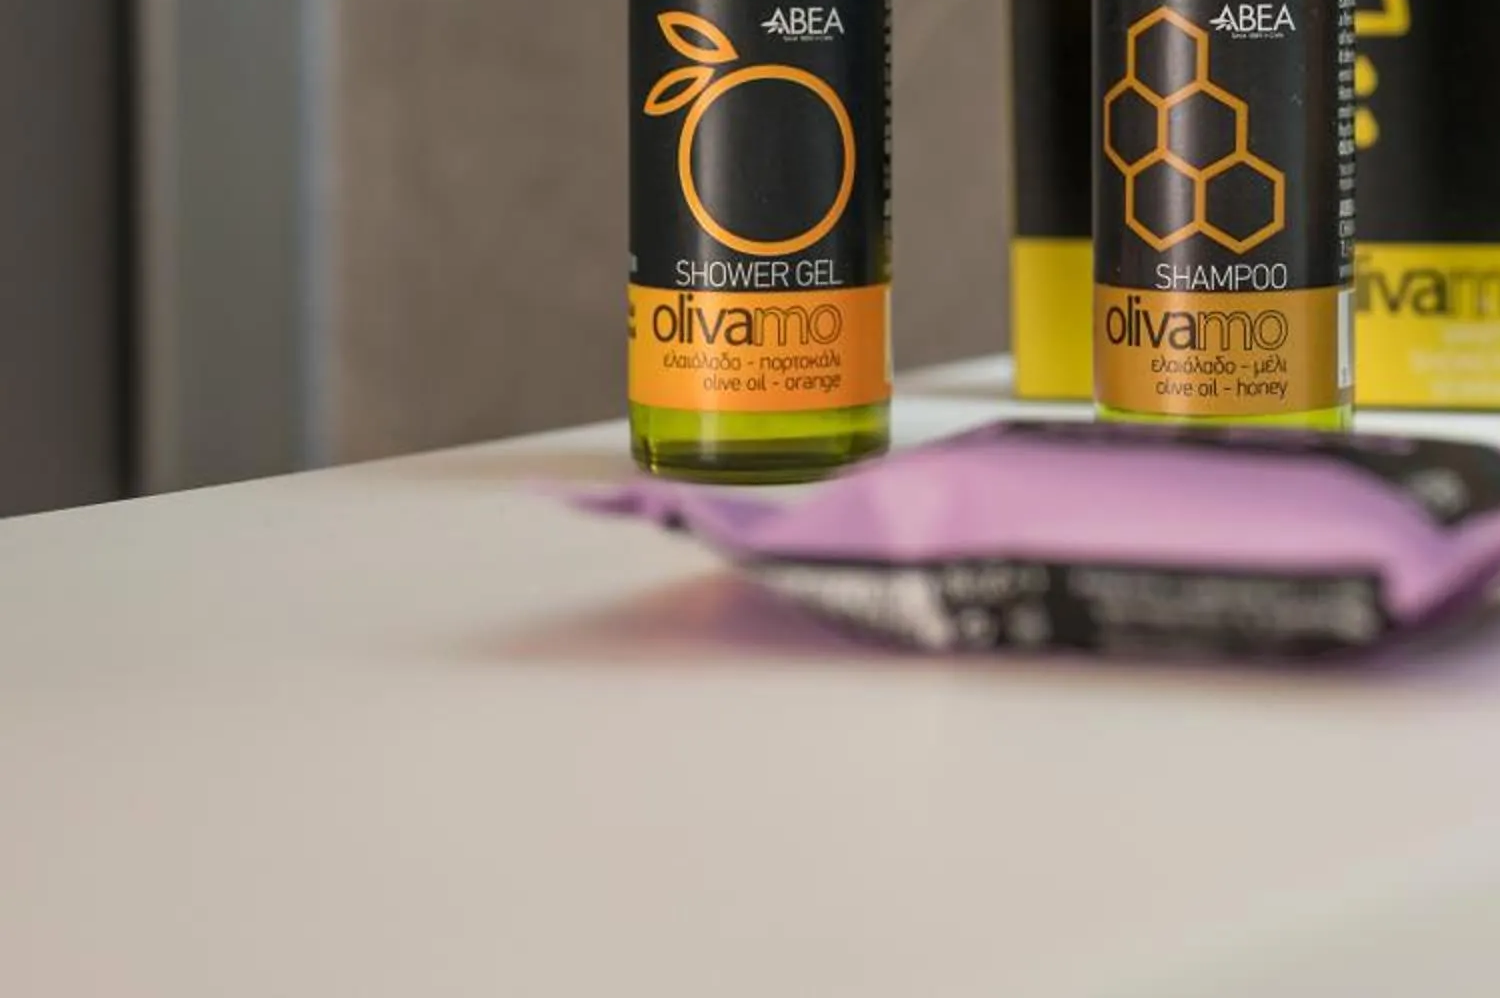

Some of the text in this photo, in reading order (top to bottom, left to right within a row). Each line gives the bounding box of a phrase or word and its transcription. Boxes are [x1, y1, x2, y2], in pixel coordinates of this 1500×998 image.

[761, 7, 845, 35] ABEA
[1209, 3, 1296, 31] ABEA
[675, 258, 844, 288] SHOWER GEL
[1155, 263, 1288, 290] SHAMPOO
[652, 292, 843, 347] olivamo
[1105, 295, 1289, 351] olivamo
[703, 374, 742, 392] olive
[745, 374, 768, 392] oil
[784, 373, 842, 394] orange
[1155, 380, 1193, 397] olive
[1197, 380, 1219, 398] oil
[1236, 378, 1289, 401] honey
